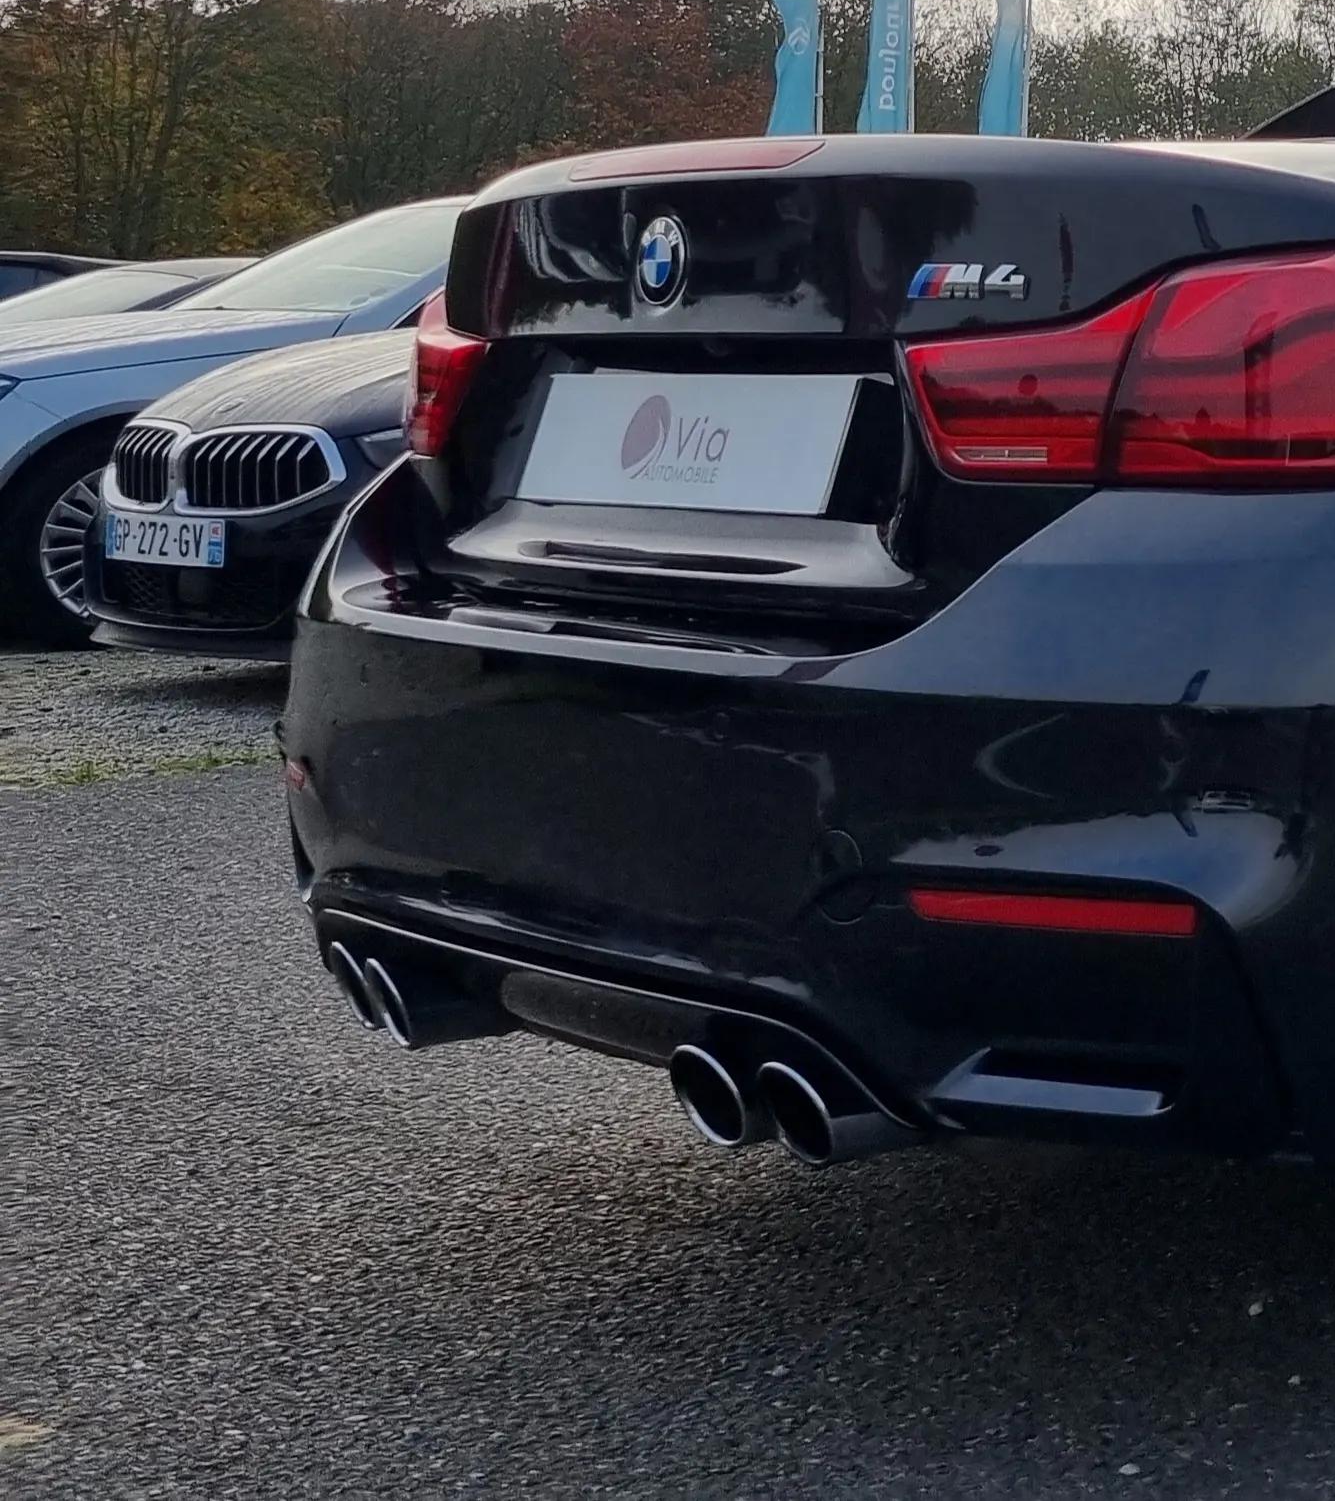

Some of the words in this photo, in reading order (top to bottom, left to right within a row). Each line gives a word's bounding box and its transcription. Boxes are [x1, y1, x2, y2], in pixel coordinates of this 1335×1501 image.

[907, 263, 1026, 299] M4
[677, 416, 730, 462] Via
[642, 465, 719, 484] AUTOMOBILE
[114, 519, 204, 558] GP-272-GV
